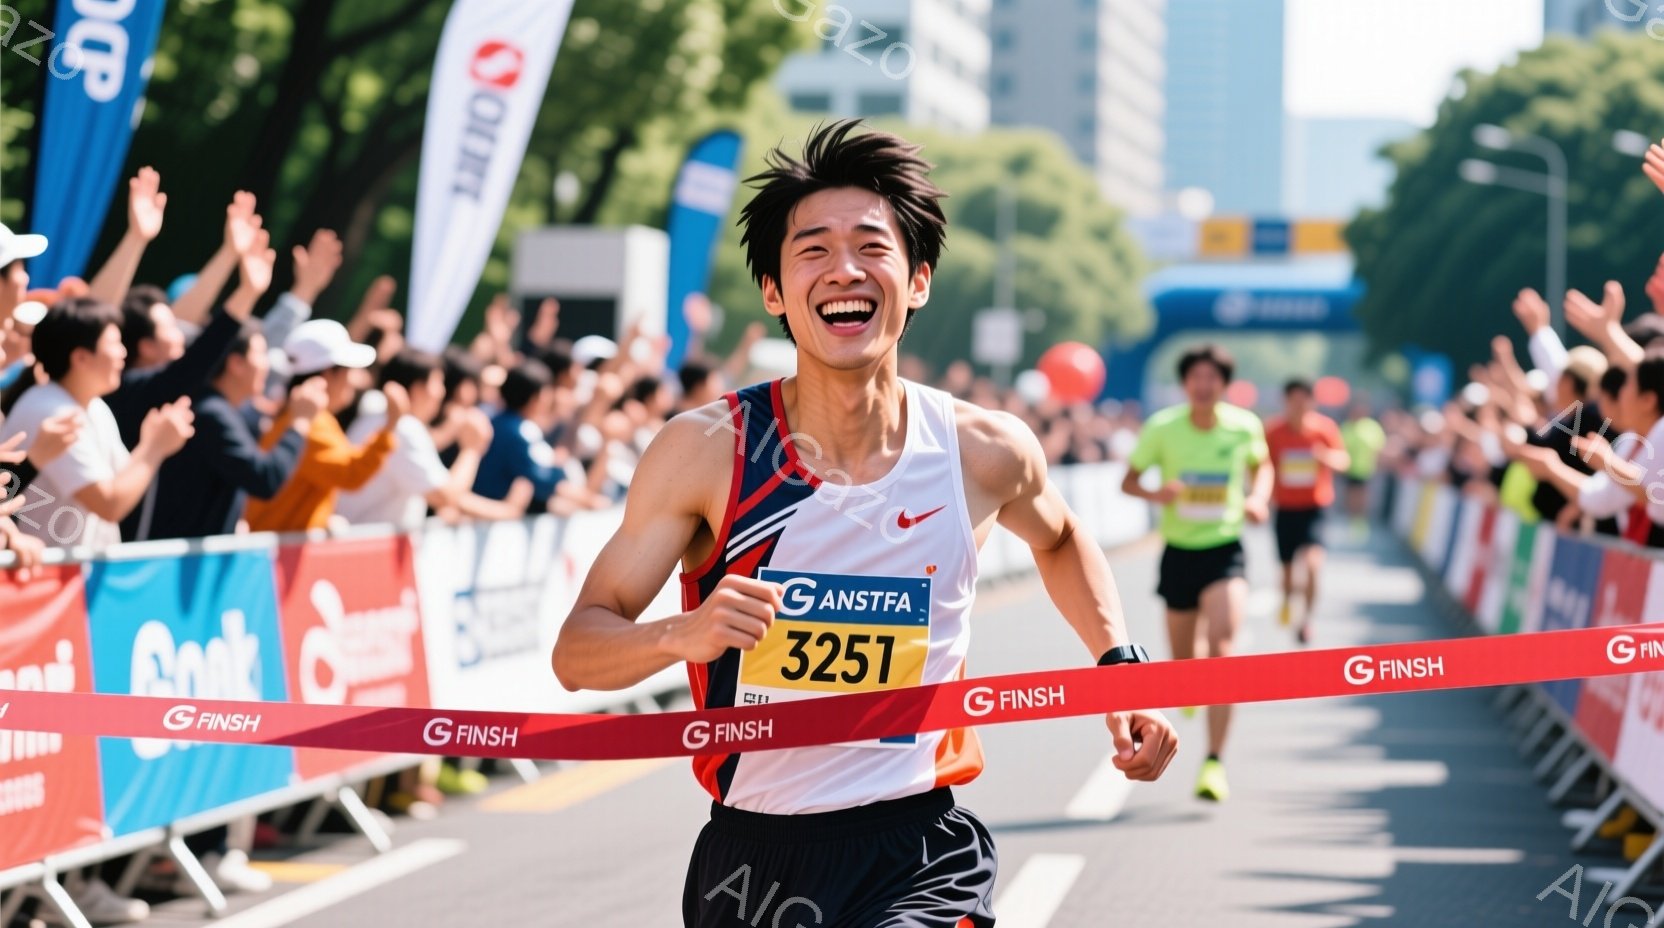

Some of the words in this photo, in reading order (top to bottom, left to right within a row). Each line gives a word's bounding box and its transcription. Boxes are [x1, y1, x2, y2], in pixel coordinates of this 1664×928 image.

[818, 589, 912, 613] ANSTFA
[780, 630, 896, 684] 3251
[1379, 655, 1444, 680] FINSH
[1000, 685, 1065, 710] FINSH
[196, 712, 262, 733] FINSH
[714, 719, 773, 744] FINSH
[456, 724, 519, 748] FINSH
